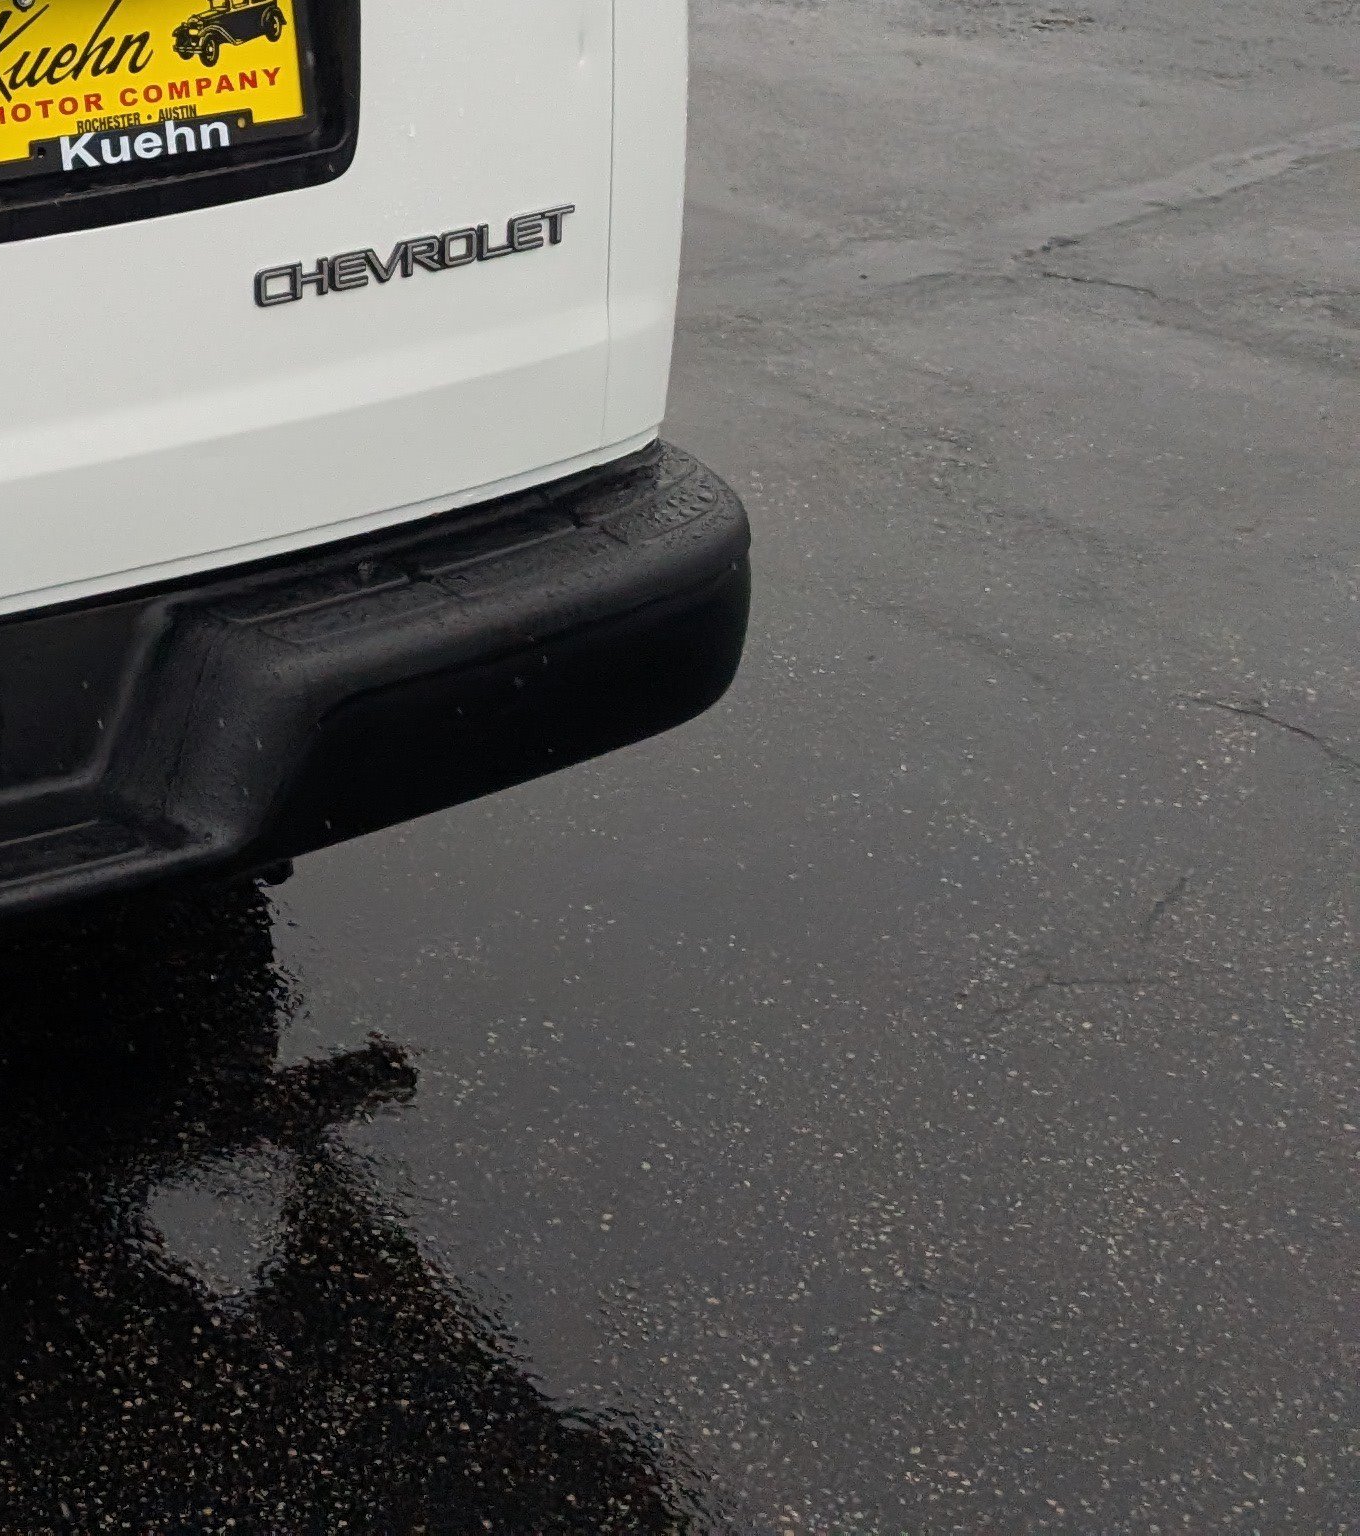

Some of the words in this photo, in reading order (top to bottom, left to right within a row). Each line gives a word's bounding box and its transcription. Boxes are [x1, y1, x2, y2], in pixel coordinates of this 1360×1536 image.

[119, 67, 281, 107] COMPANY
[77, 112, 141, 134] ROCHESTER
[158, 104, 197, 121] AUSTIN
[59, 120, 230, 171] Kuehn
[254, 203, 576, 307] CHEVROLET
